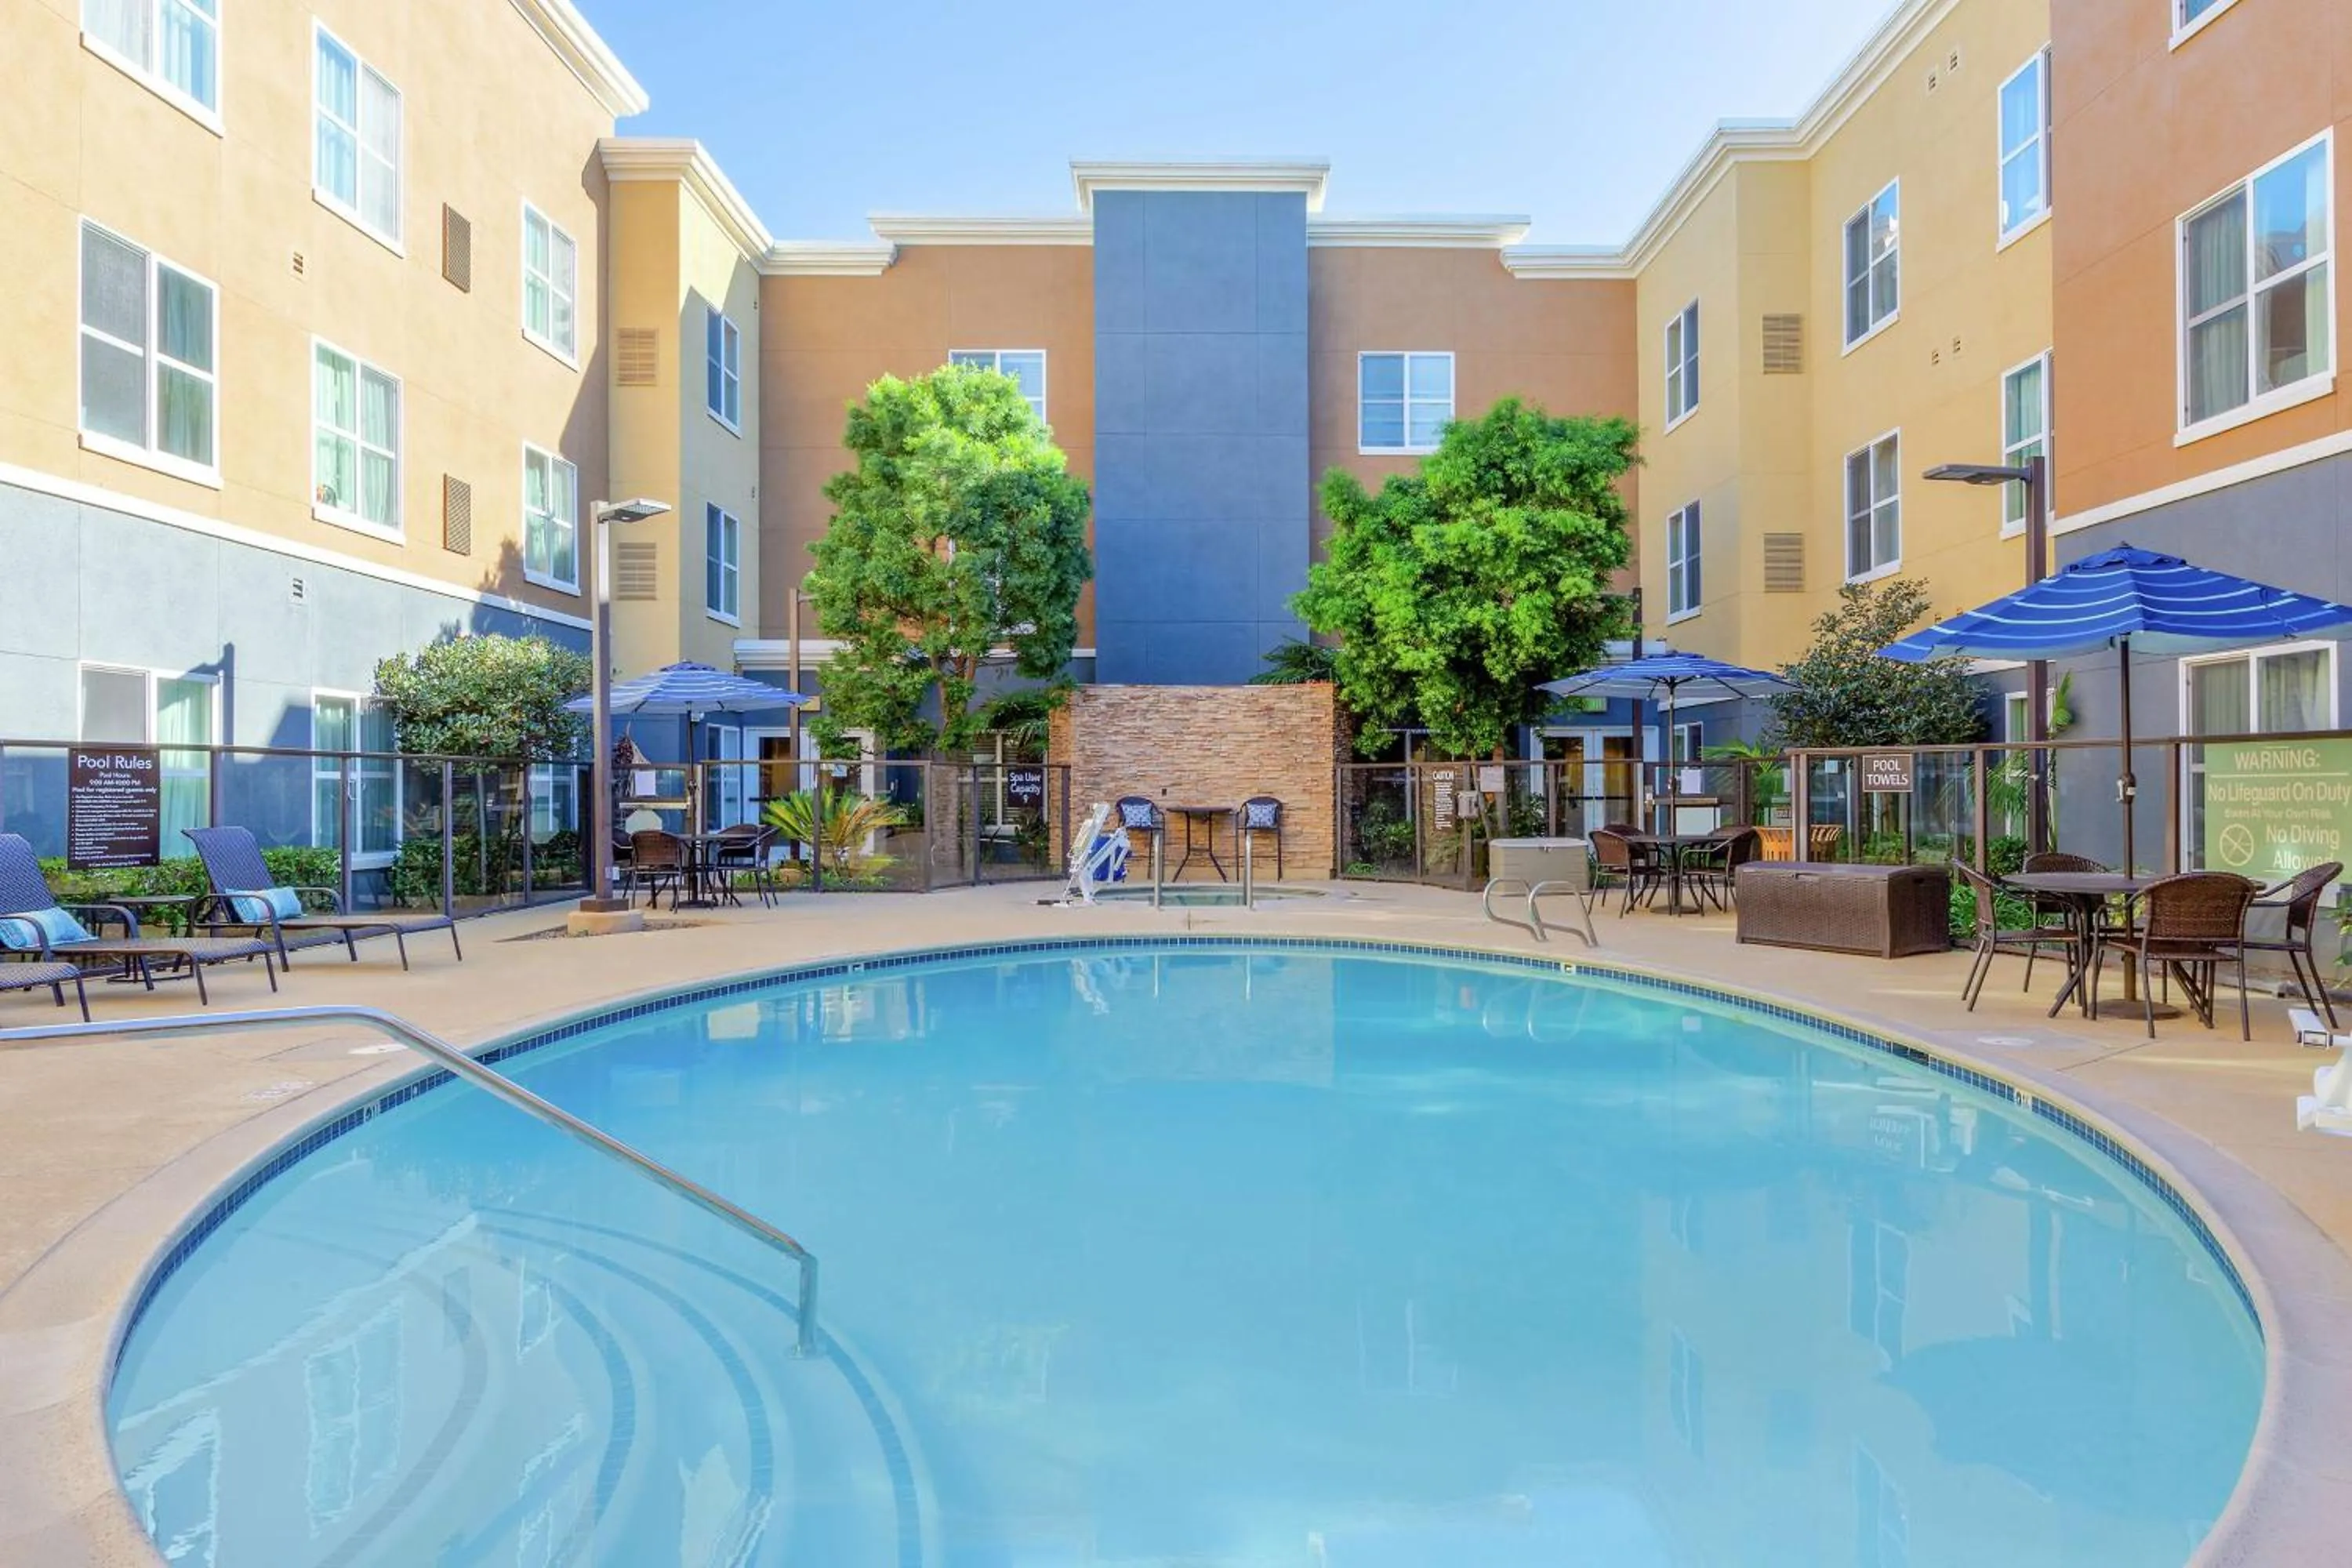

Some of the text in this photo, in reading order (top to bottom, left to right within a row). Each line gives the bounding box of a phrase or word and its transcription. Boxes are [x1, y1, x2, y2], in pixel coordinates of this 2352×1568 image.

[78, 755, 153, 770] Pool Rules
[1873, 759, 1901, 772] POOL
[2234, 749, 2321, 770] WARNING:
[1009, 772, 1041, 786] Spa User
[1866, 774, 1908, 786] TOWELS
[2208, 782, 2351, 808] No Lifeguard On Duty
[2266, 824, 2339, 850] No Diving
